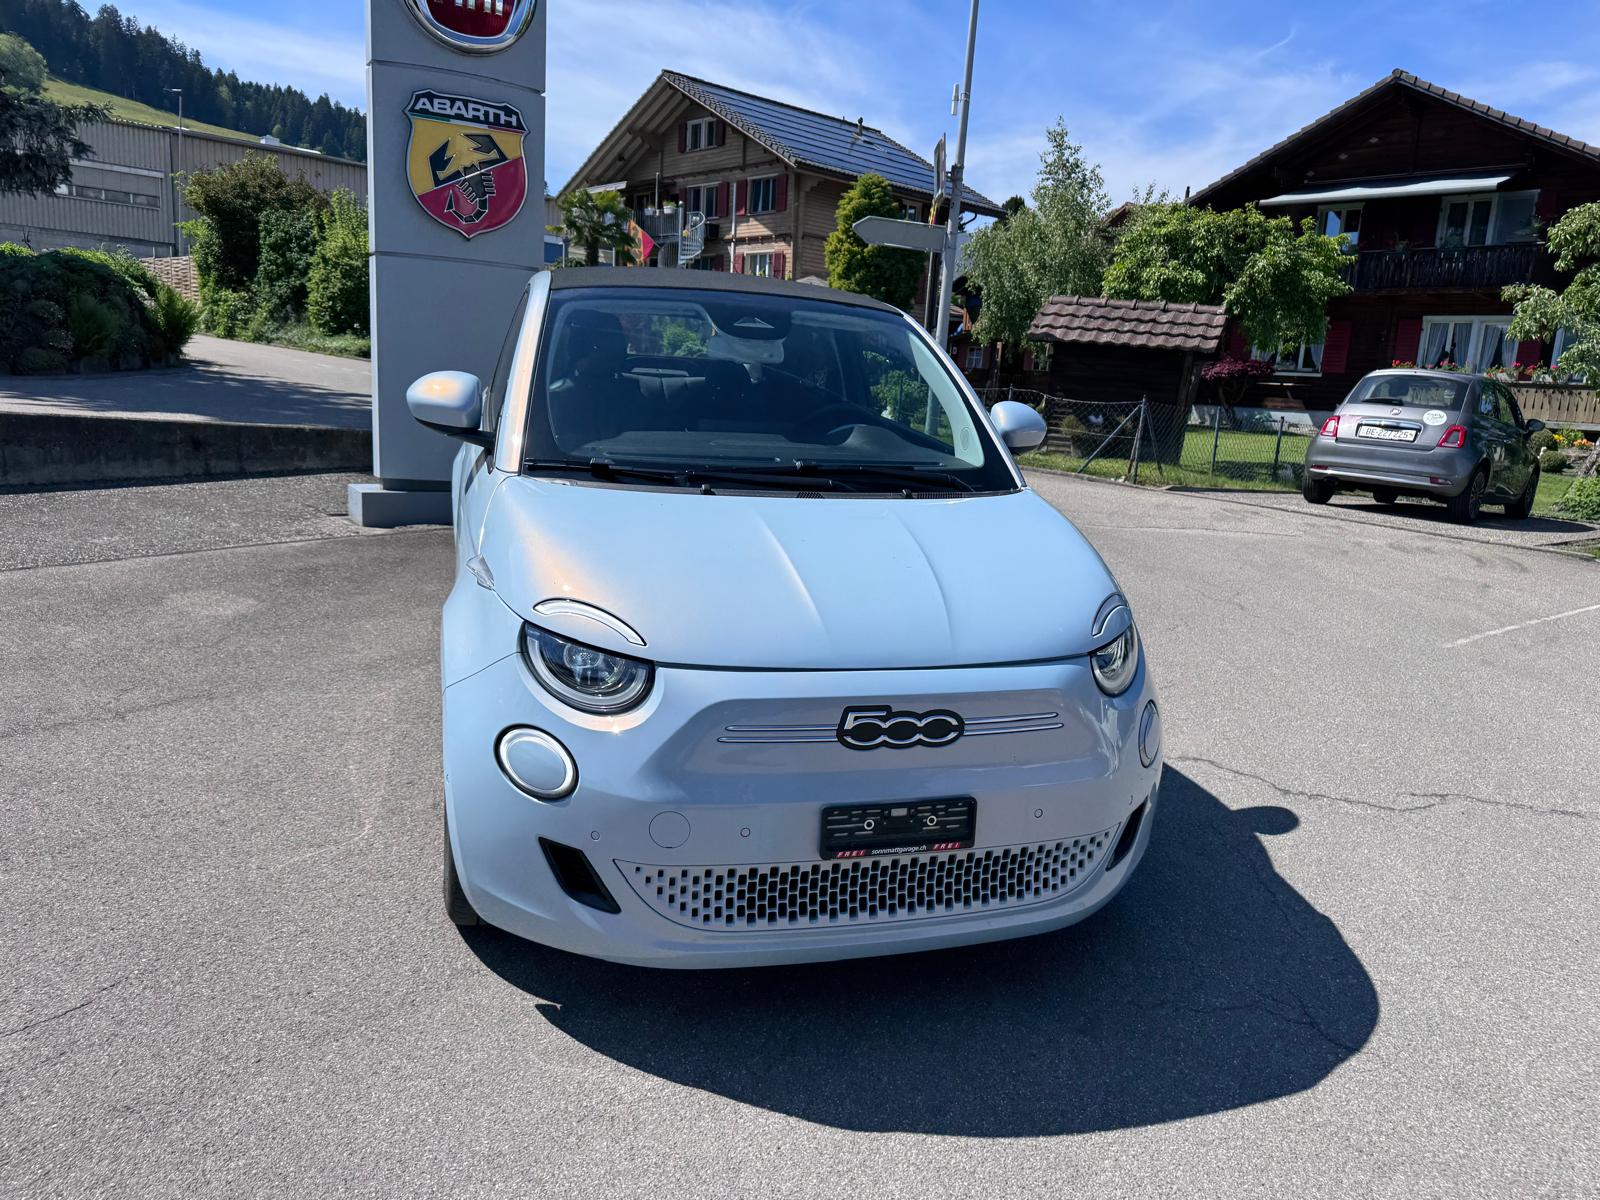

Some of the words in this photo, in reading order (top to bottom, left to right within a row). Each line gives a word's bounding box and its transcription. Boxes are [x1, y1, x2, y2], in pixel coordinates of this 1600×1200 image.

[413, 97, 517, 126] ABARTH
[840, 707, 963, 749] 500
[836, 850, 865, 858] FREI
[871, 845, 927, 855] sonnmattgarage.ch
[933, 842, 960, 850] FREI
